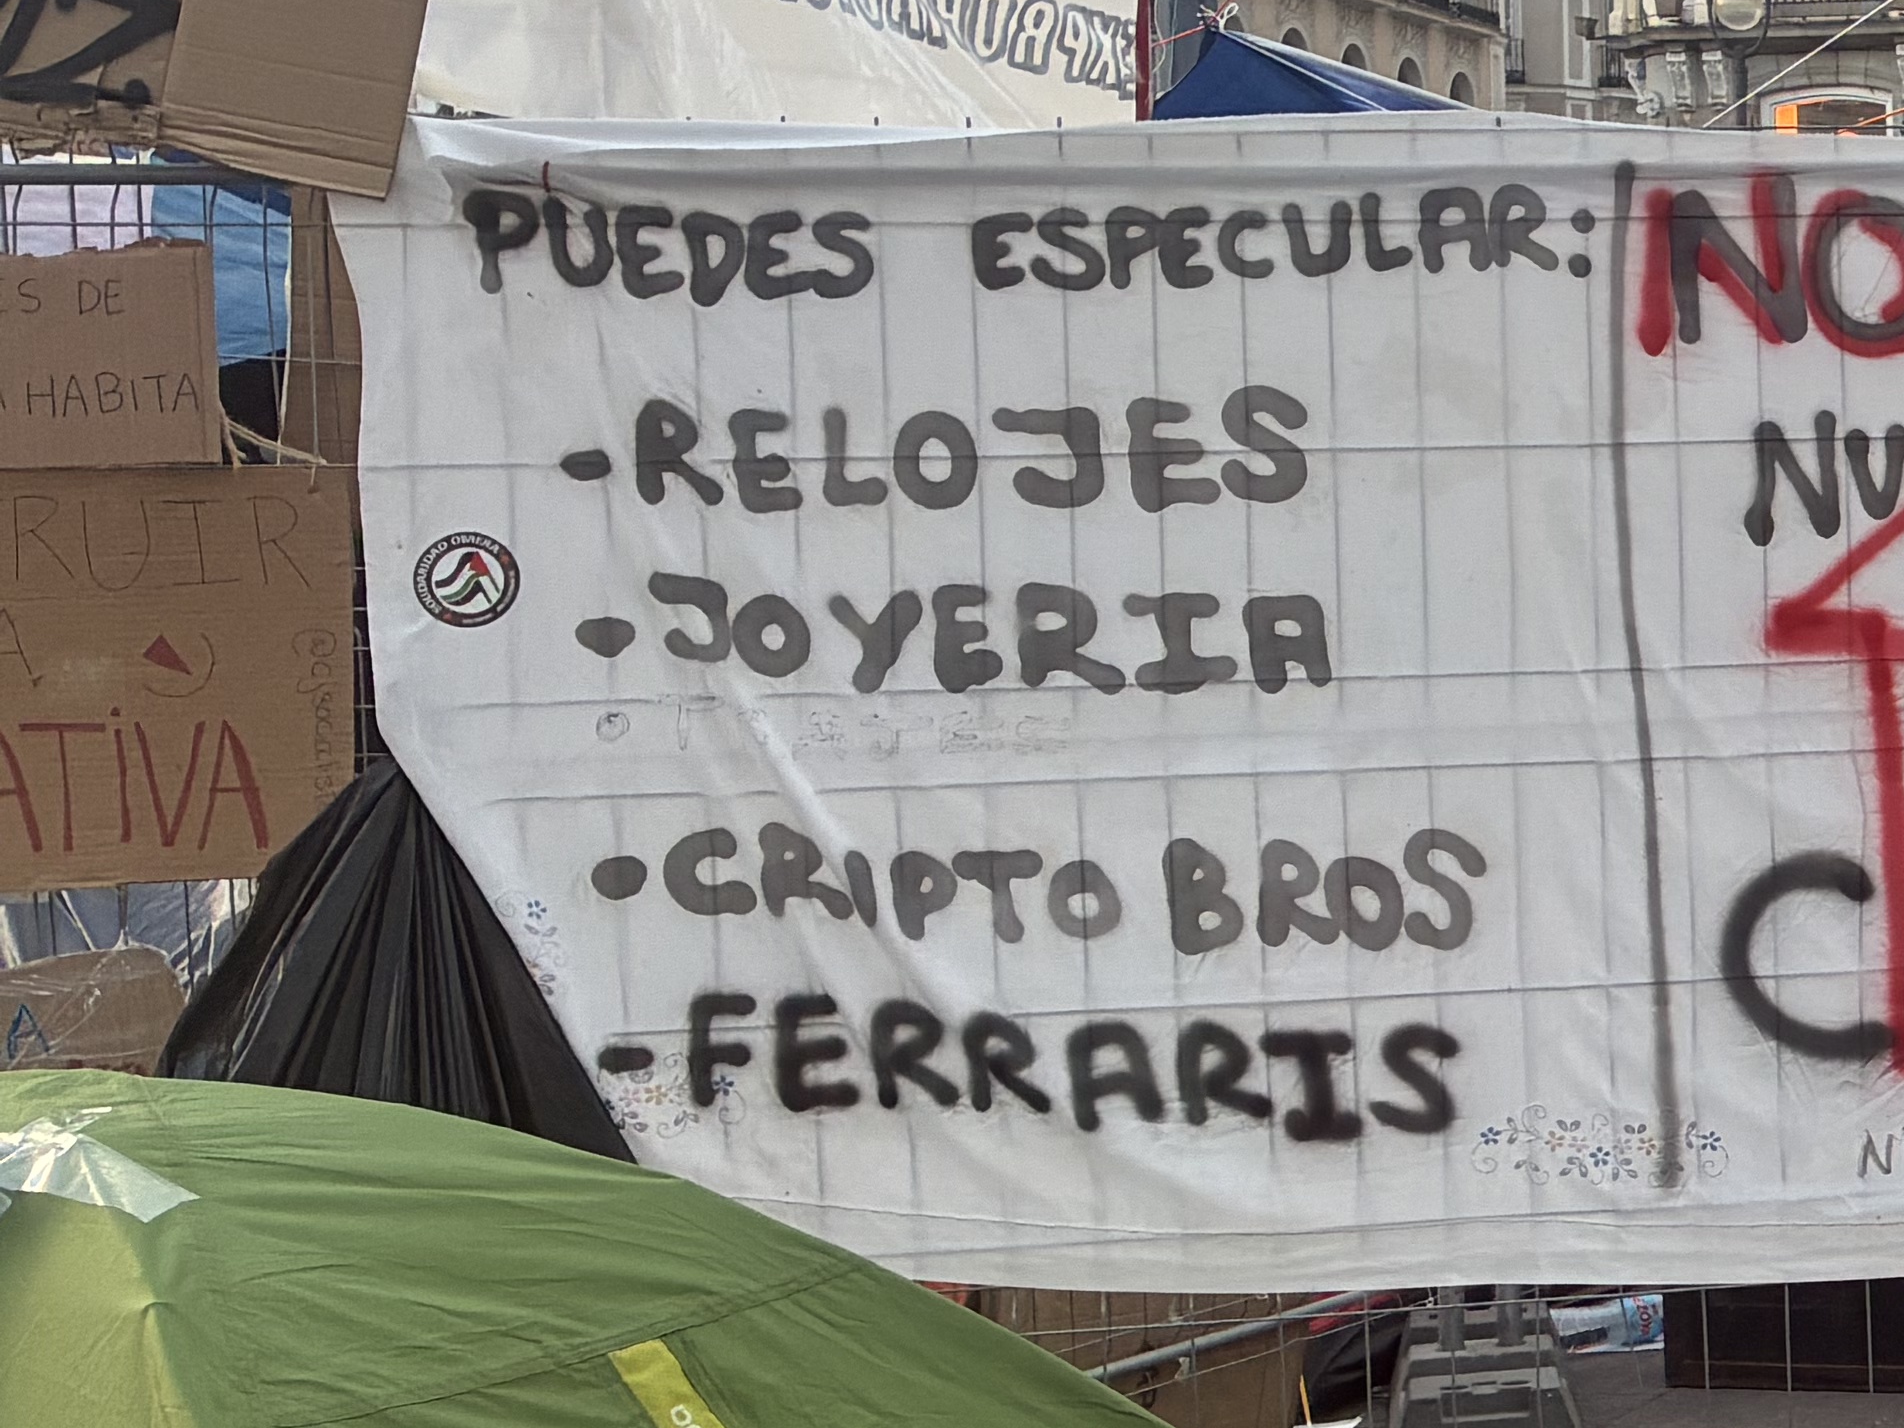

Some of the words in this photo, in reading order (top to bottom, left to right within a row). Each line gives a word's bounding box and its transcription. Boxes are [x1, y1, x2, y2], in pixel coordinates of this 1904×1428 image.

[461, 187, 876, 308] PUEDES
[970, 183, 1597, 293] ESPECULAR:
[0, 277, 41, 314] S
[78, 278, 125, 315] DE
[26, 371, 201, 418] HABITA
[1162, 827, 1487, 957] BROS
